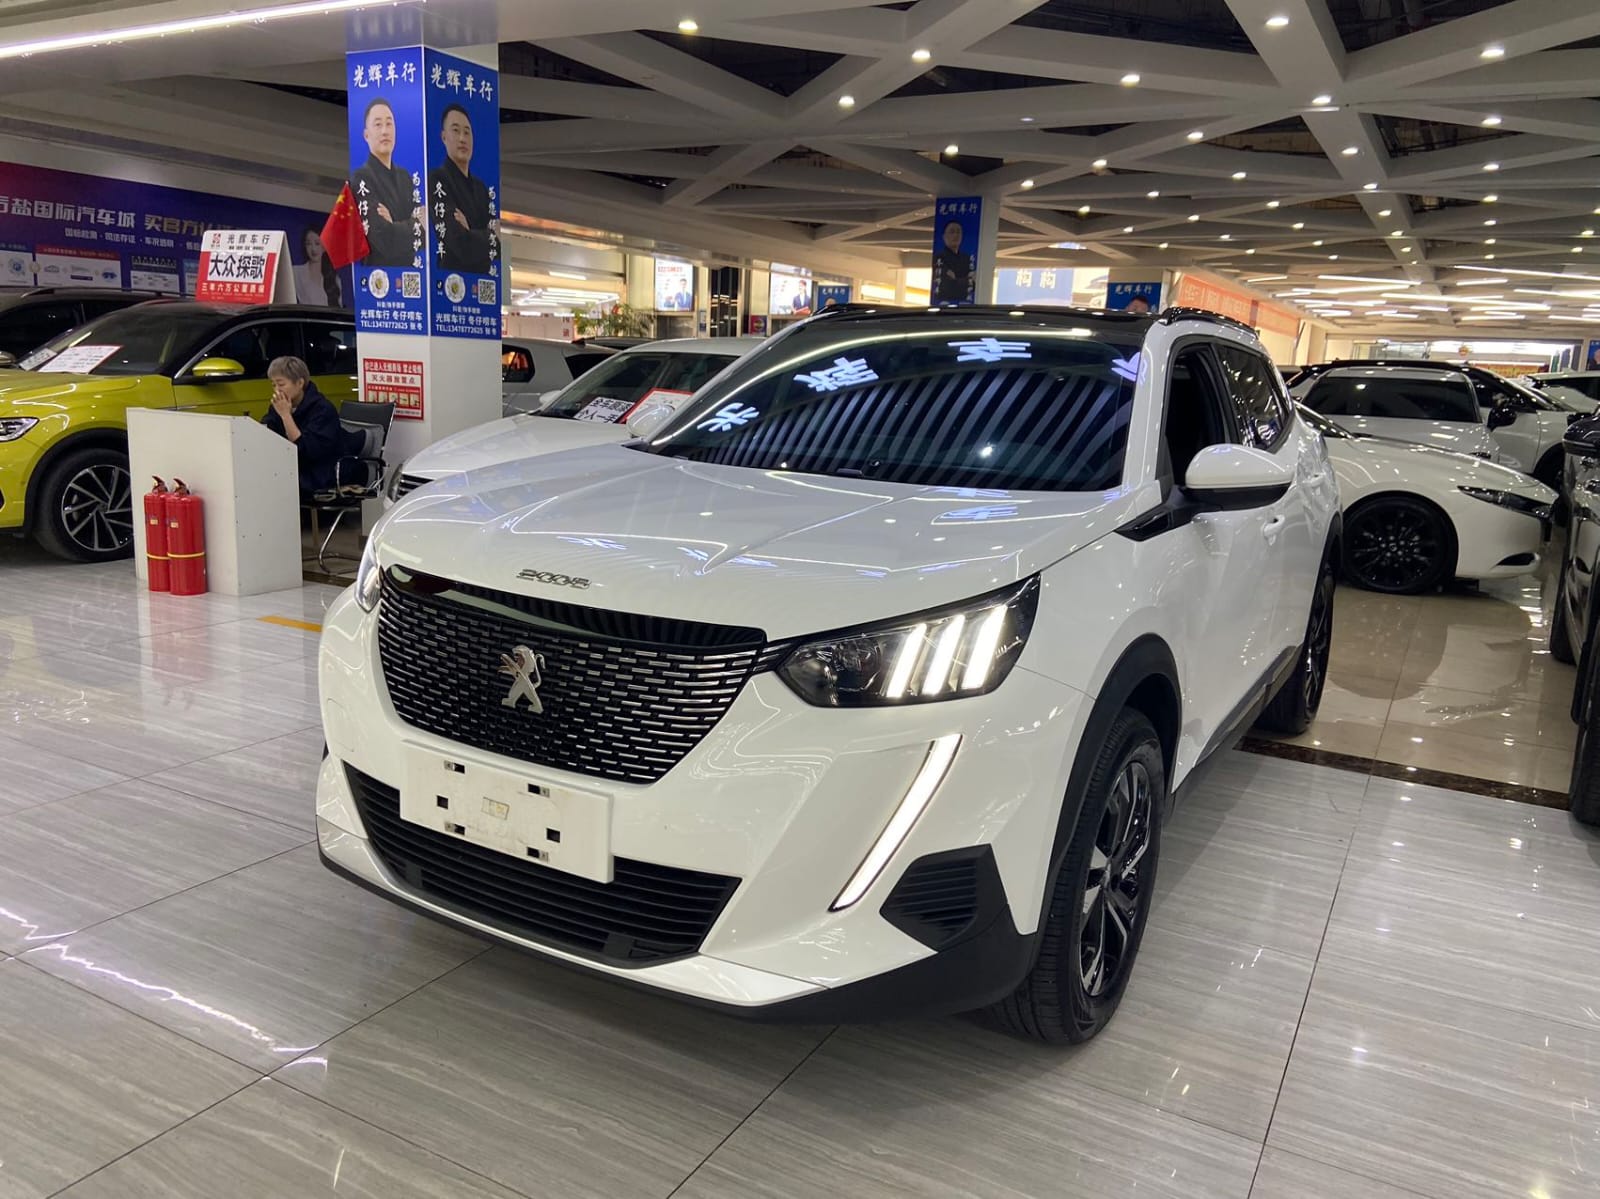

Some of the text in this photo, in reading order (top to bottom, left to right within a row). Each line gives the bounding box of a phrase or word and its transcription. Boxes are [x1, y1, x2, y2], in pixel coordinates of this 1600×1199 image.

[353, 61, 417, 88] 光辉车行
[430, 63, 494, 102] 光辉车行
[227, 233, 270, 245] 光辉车行
[208, 253, 266, 279] 大众探歌
[515, 568, 592, 590] 2008
